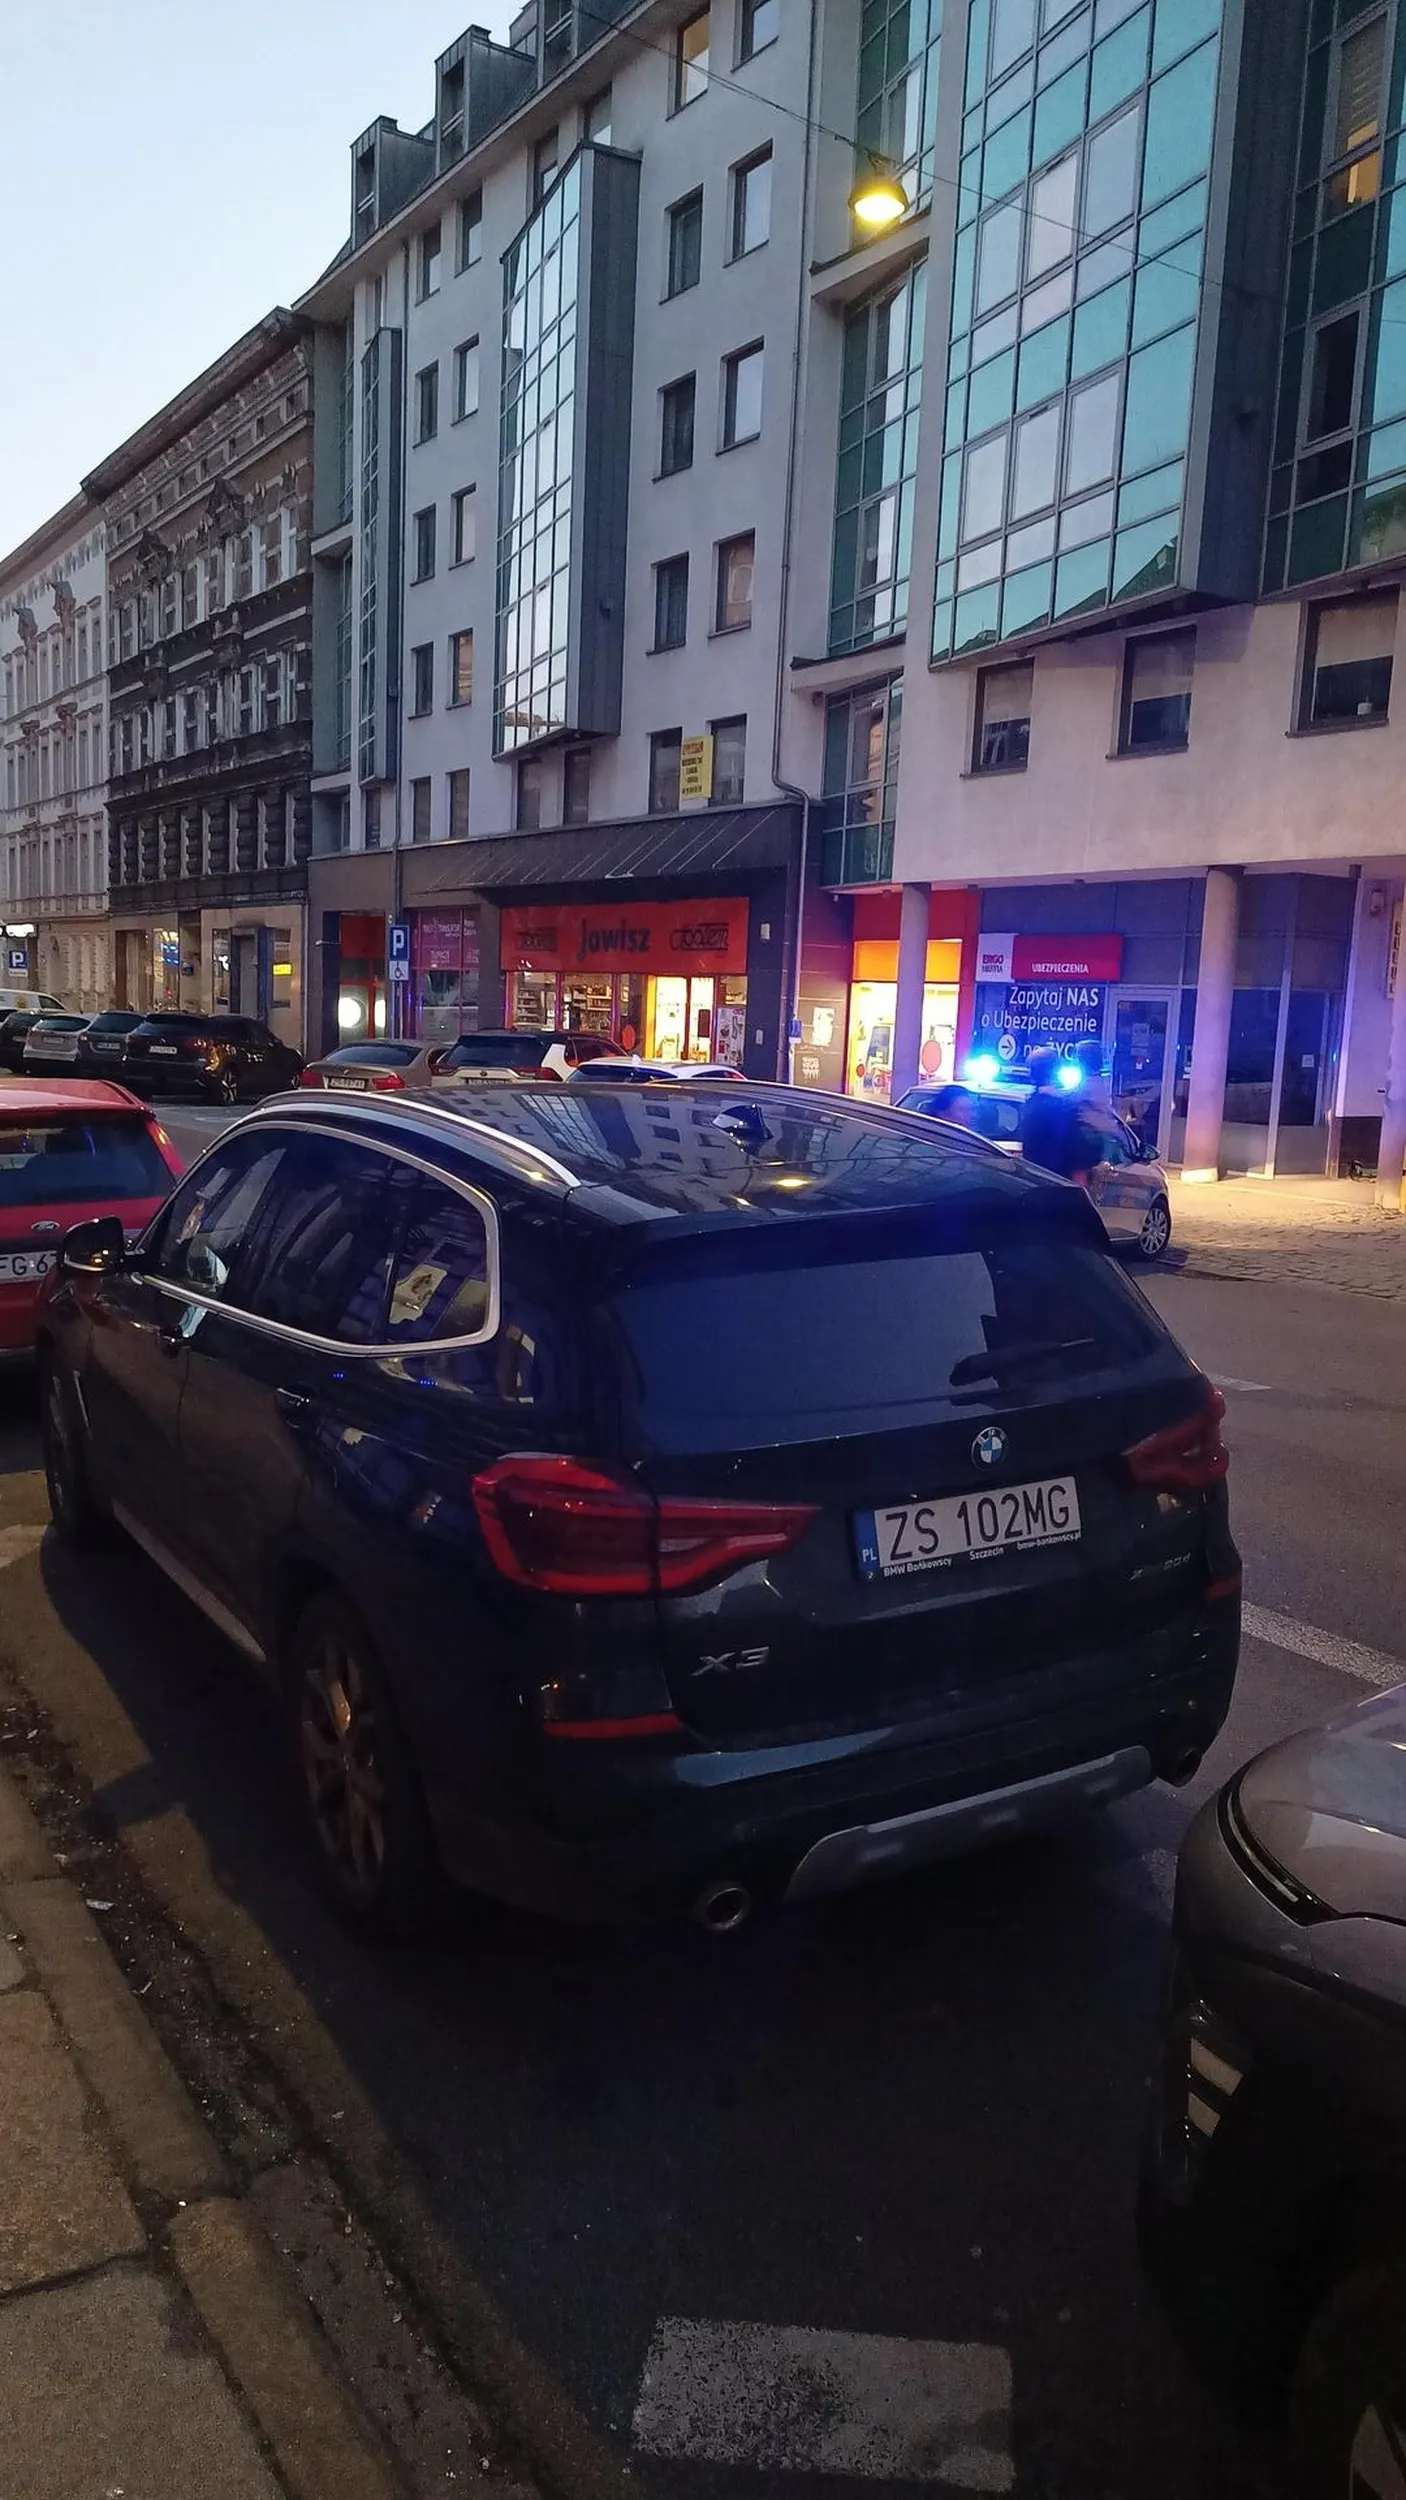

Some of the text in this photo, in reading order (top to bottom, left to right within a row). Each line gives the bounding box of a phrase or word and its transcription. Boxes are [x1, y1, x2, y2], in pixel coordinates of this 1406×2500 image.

[392, 929, 405, 957] P
[11, 951, 24, 967] P
[1031, 963, 1090, 974] UBEZPIECZENIA
[1009, 986, 1099, 1011] Zapytaj NAS
[981, 1010, 1097, 1036] o Ubezpieczenie
[36, 1253, 57, 1274] 6
[885, 1484, 1070, 1561] ZS 102MG
[862, 1547, 878, 1563] PL
[883, 1564, 906, 1577] BMW
[969, 1546, 1005, 1561] Szczecin
[689, 1645, 770, 1677] X3
